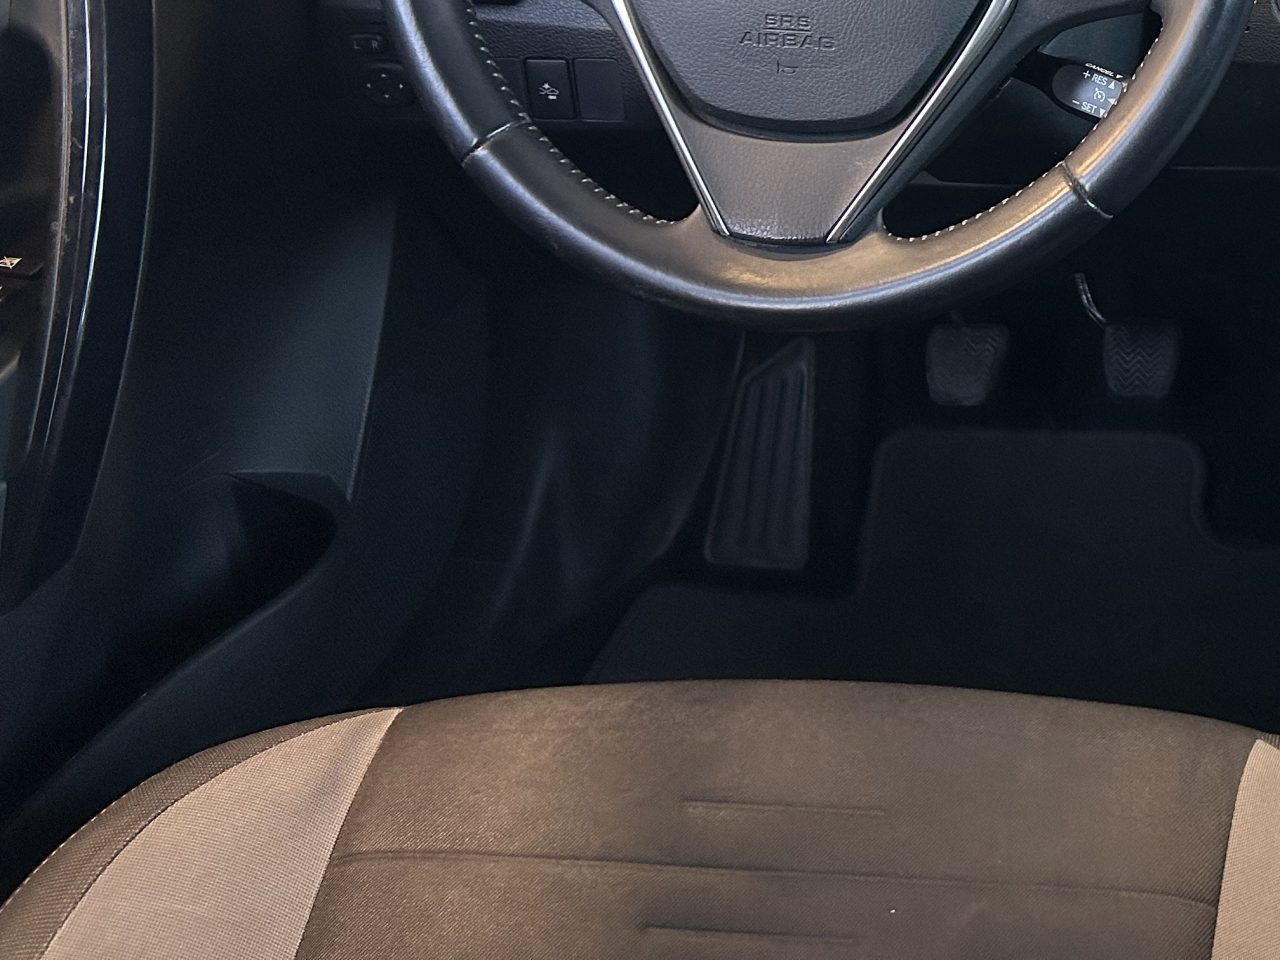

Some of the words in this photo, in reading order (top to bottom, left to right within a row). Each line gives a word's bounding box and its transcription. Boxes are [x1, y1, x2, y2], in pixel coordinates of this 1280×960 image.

[739, 31, 836, 51] AIRBAG
[1085, 62, 1115, 77] CANCEL
[1091, 73, 1107, 86] RES
[1081, 102, 1097, 114] SET
